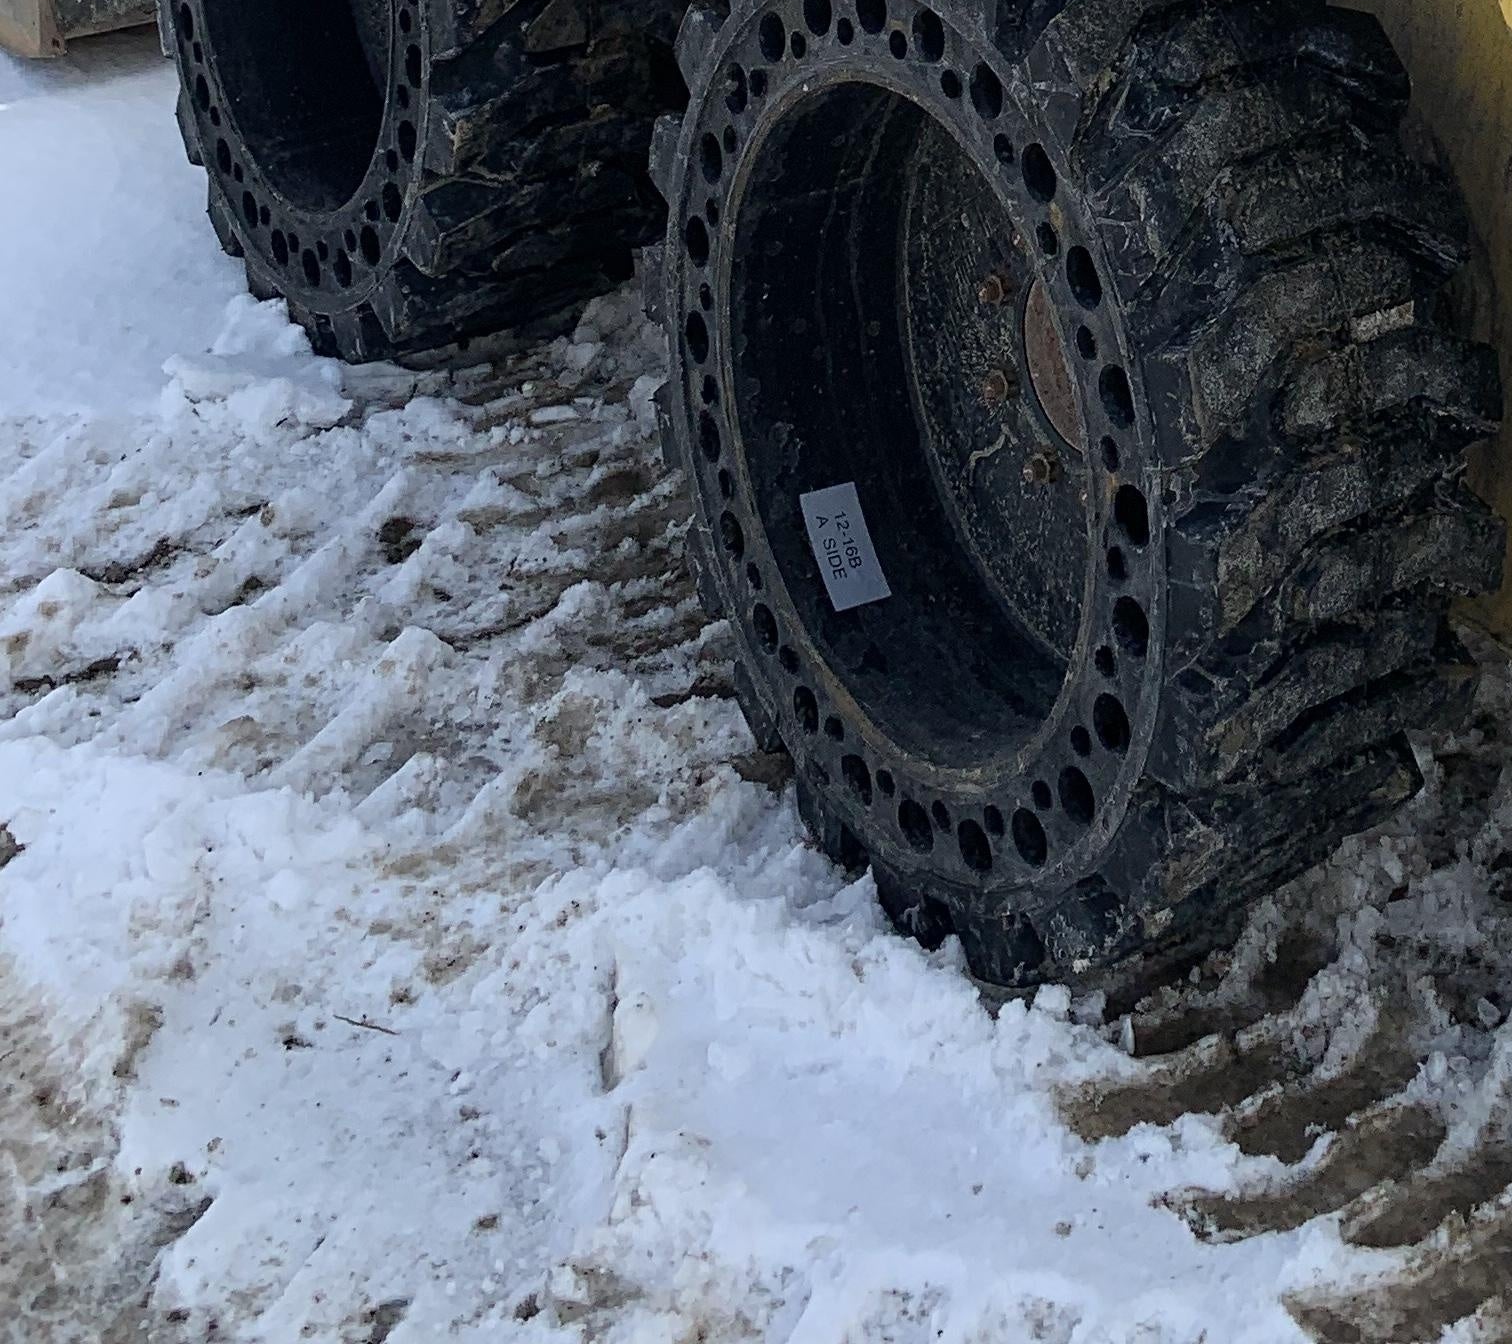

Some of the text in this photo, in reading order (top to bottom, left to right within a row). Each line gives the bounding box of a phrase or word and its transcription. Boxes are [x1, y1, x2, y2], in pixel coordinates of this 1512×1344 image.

[815, 515, 848, 581] A SIDE
[834, 510, 863, 569] 12-16B
